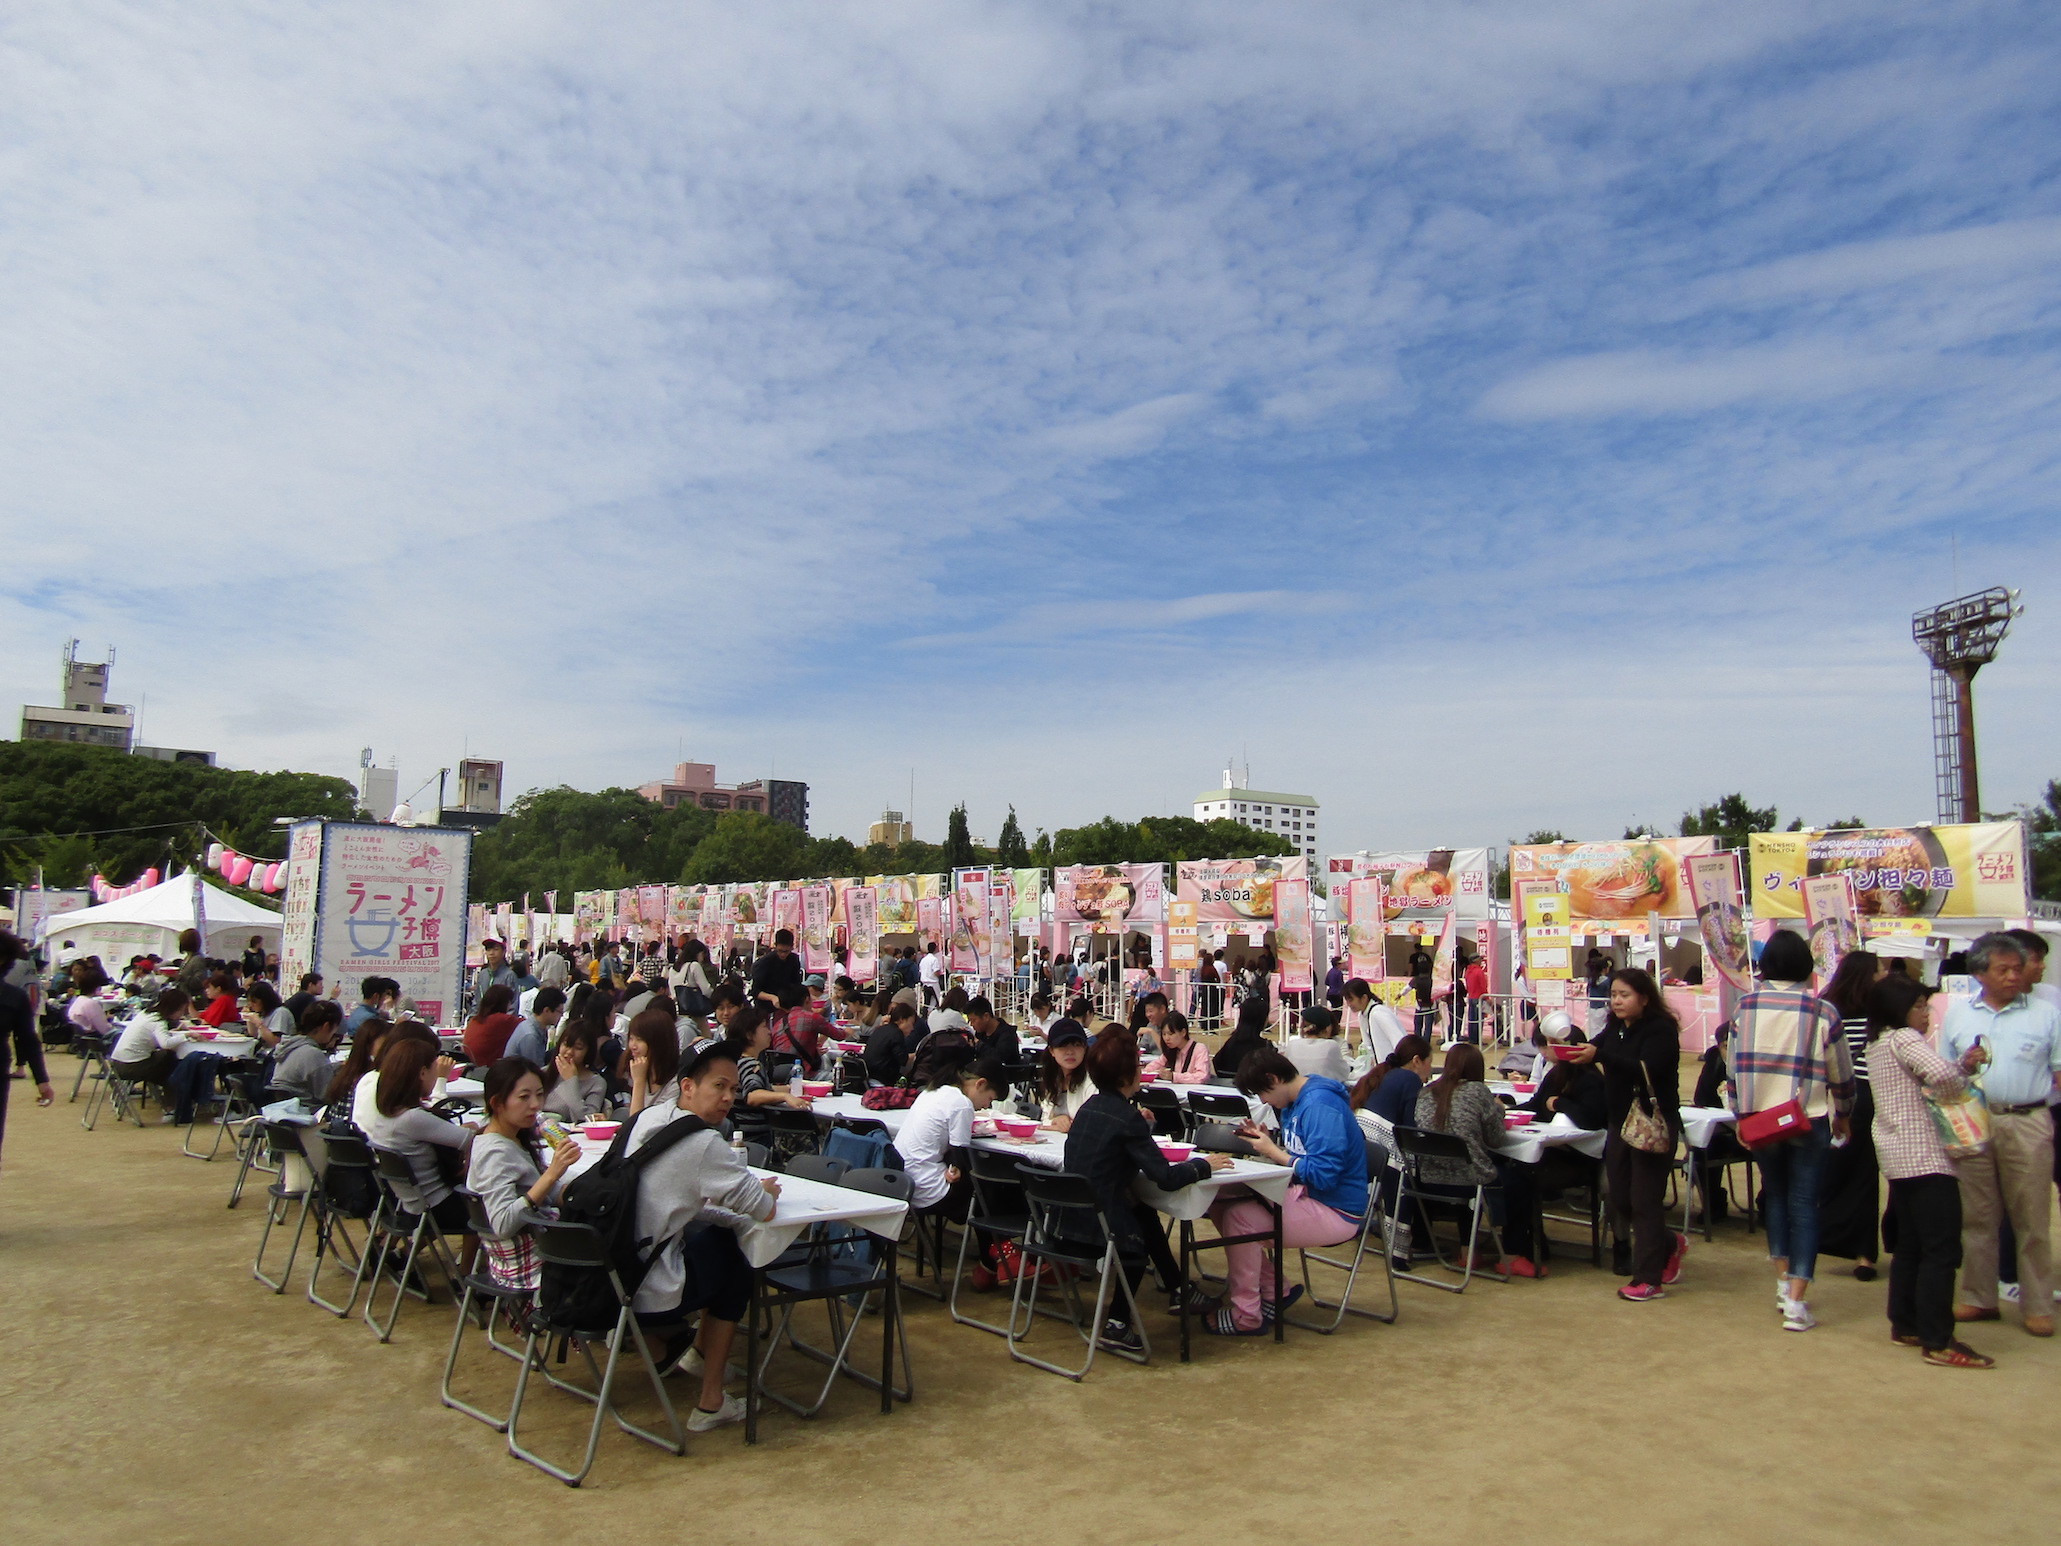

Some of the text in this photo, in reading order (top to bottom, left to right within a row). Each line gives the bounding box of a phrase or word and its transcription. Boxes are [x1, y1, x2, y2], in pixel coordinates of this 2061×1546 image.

[346, 882, 443, 917] ラーメン
[408, 944, 435, 959] 大阪
